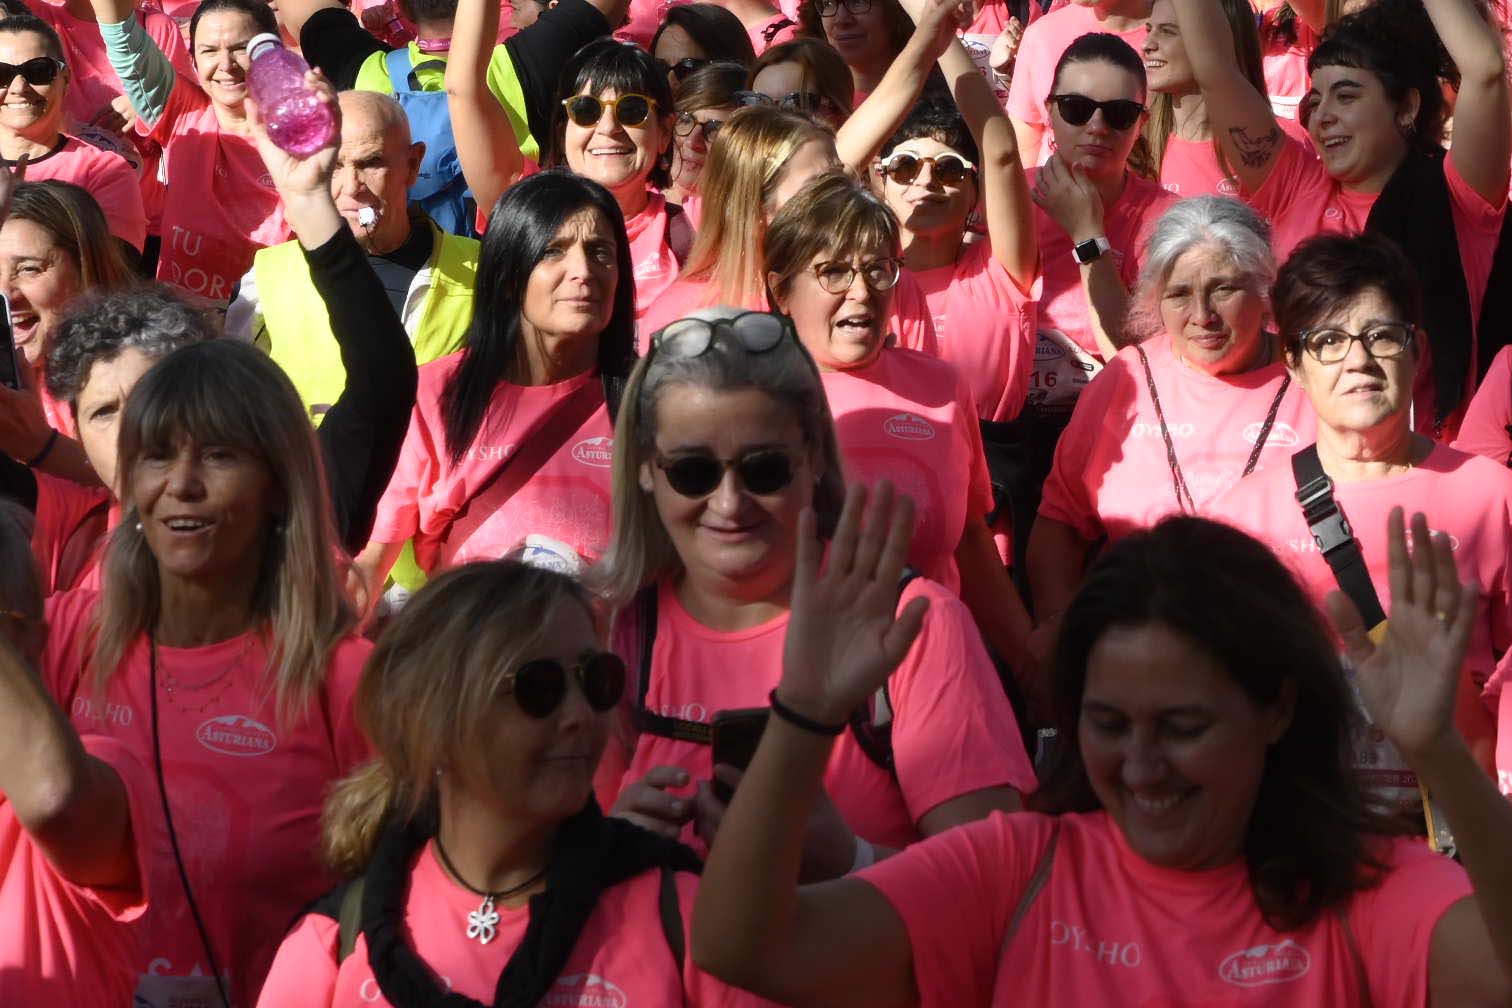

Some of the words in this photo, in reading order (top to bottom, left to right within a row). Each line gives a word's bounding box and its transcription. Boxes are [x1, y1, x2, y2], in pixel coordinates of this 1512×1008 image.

[172, 225, 204, 256] TU
[203, 725, 270, 750] ASTURIANA
[1226, 956, 1306, 982] ASTURIANA
